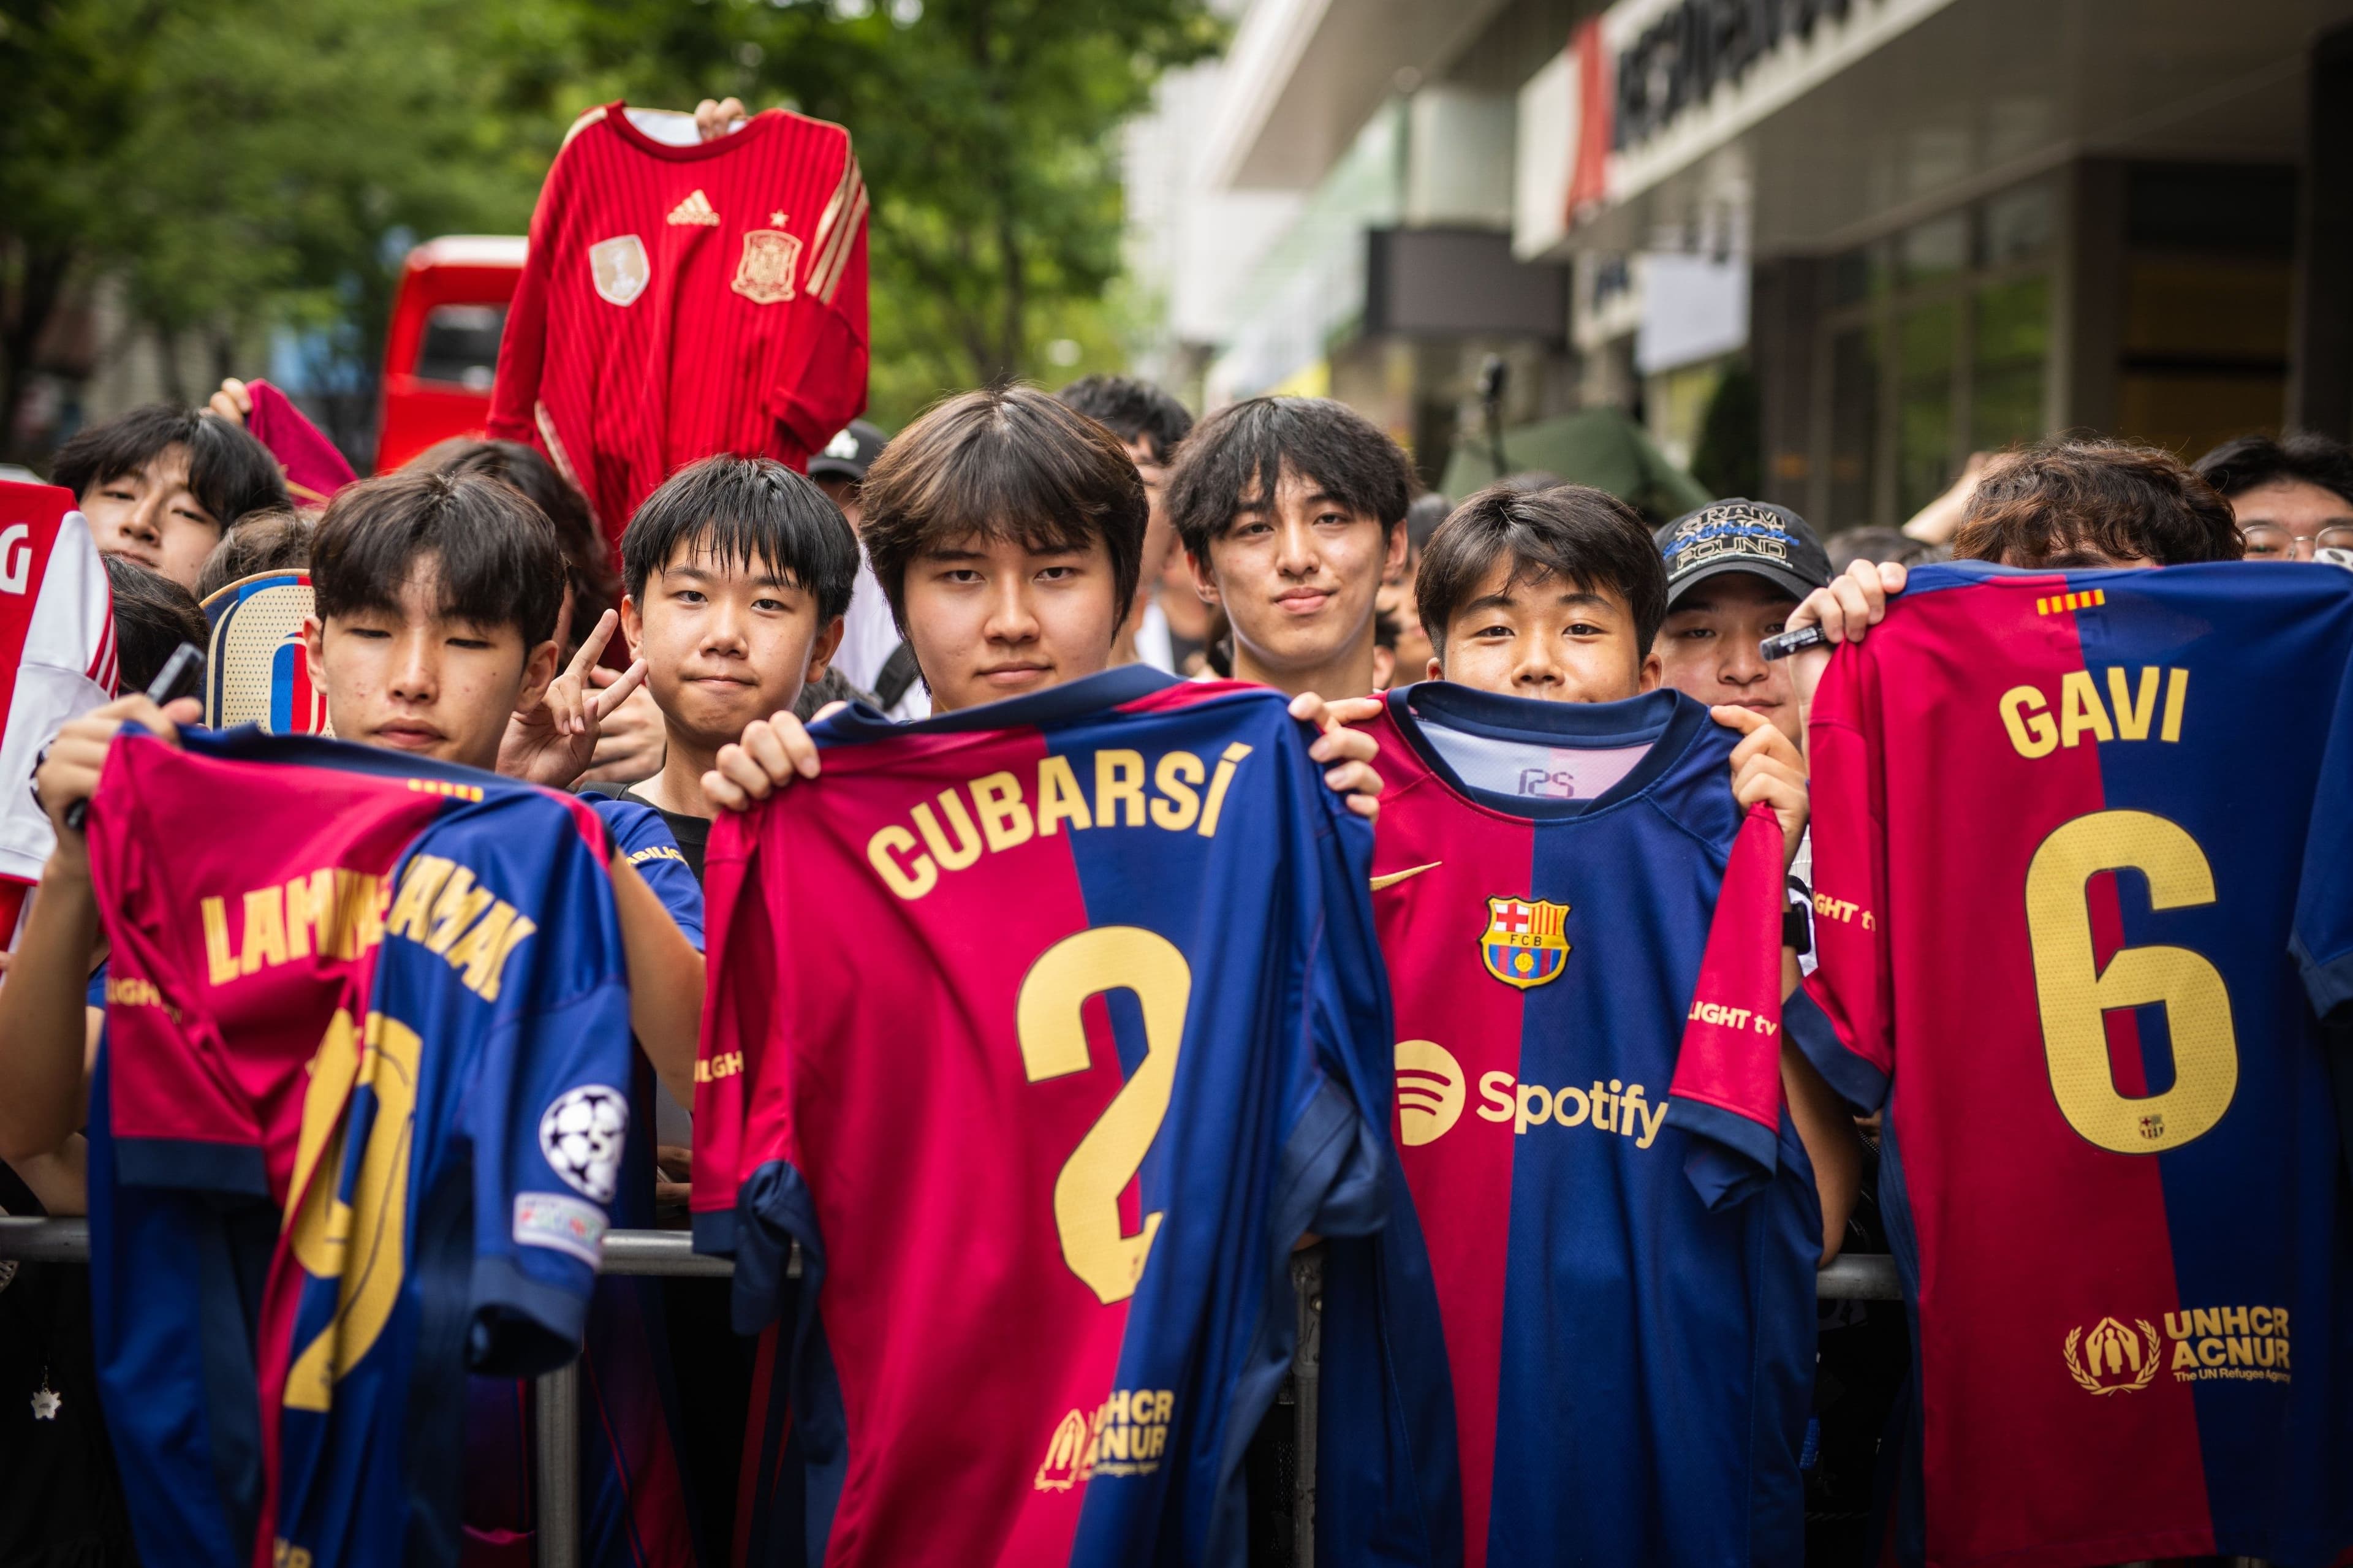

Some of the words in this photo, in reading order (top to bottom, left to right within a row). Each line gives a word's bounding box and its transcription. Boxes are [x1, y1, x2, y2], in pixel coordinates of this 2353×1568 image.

[1677, 537, 1787, 570] POUND
[1999, 666, 2189, 759] GAVI
[867, 741, 1253, 900] CUBARSÍ
[1814, 891, 1860, 923] GHT
[2025, 809, 2240, 1156] 6
[1688, 1000, 1752, 1030] IGHT
[1753, 1015, 1778, 1037] tv
[1015, 925, 1192, 1306] 2
[1476, 1070, 1669, 1149] Spotify
[2164, 1306, 2289, 1340] UNHCR
[2170, 1336, 2290, 1370] ACNUR
[2173, 1371, 2197, 1382] The
[2199, 1368, 2217, 1379] UN
[2219, 1368, 2264, 1381] Refugee
